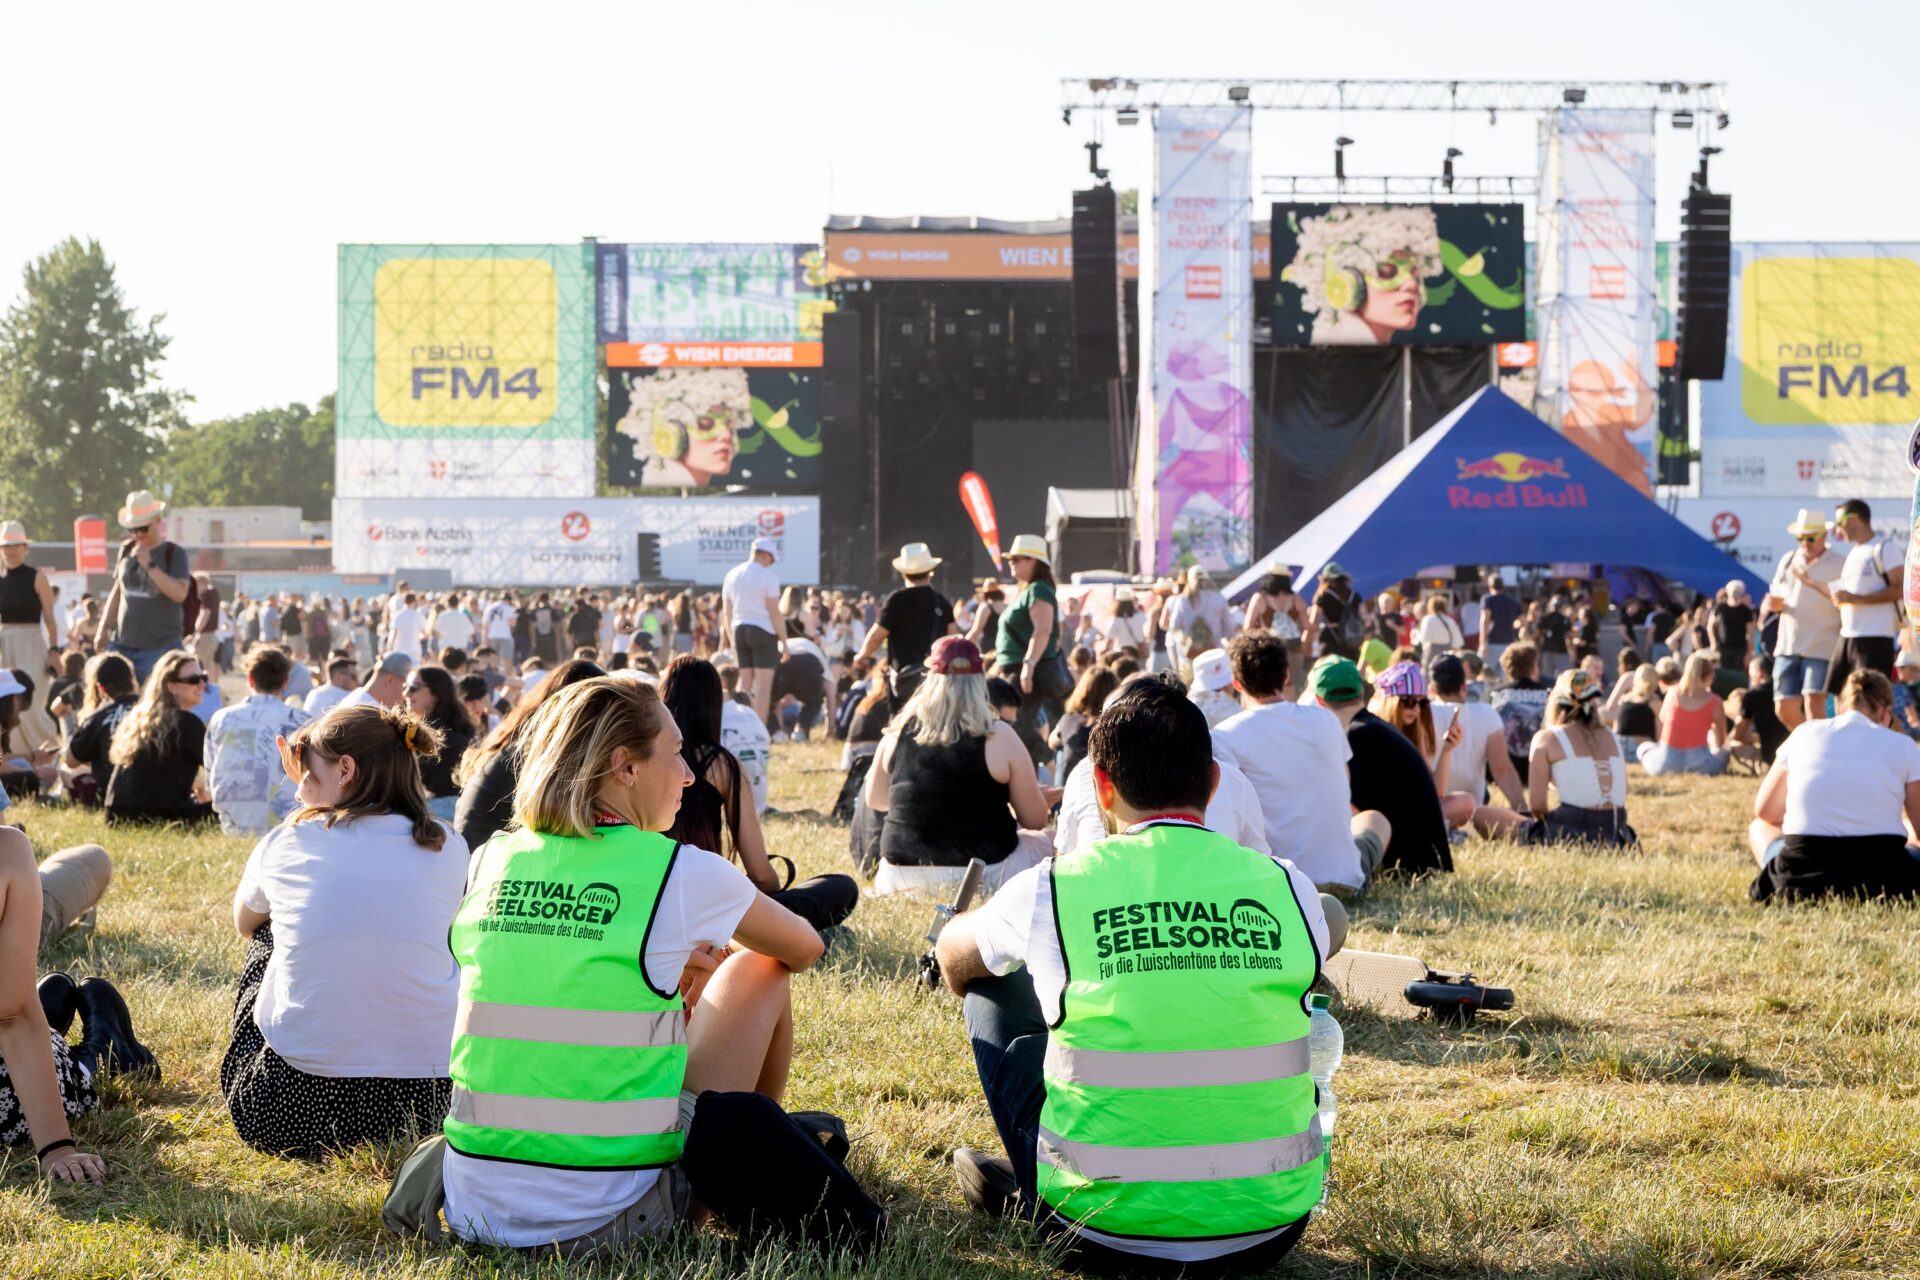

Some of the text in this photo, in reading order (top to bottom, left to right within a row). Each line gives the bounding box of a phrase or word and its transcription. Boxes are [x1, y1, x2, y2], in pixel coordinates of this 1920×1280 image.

[868, 250, 950, 261] WIEN ENERGIE
[999, 247, 1057, 267] WIEN
[411, 341, 495, 361] radio
[674, 346, 794, 362] WIEN ENERGIE
[1777, 339, 1862, 360] radio
[411, 366, 543, 401] FM4
[1777, 364, 1911, 399] FM4
[1447, 484, 1588, 509] Red Bull
[385, 526, 473, 541] Bank Austria
[698, 525, 757, 537] WIENER
[489, 879, 577, 902] FESTIVAL
[1093, 901, 1228, 934] FESTIVAL
[478, 918, 604, 942] Für die Zwischentöne des Lebens
[1096, 925, 1270, 959] SEELSORGE
[1099, 950, 1283, 981] Für die Zwischentöne des Lebens
